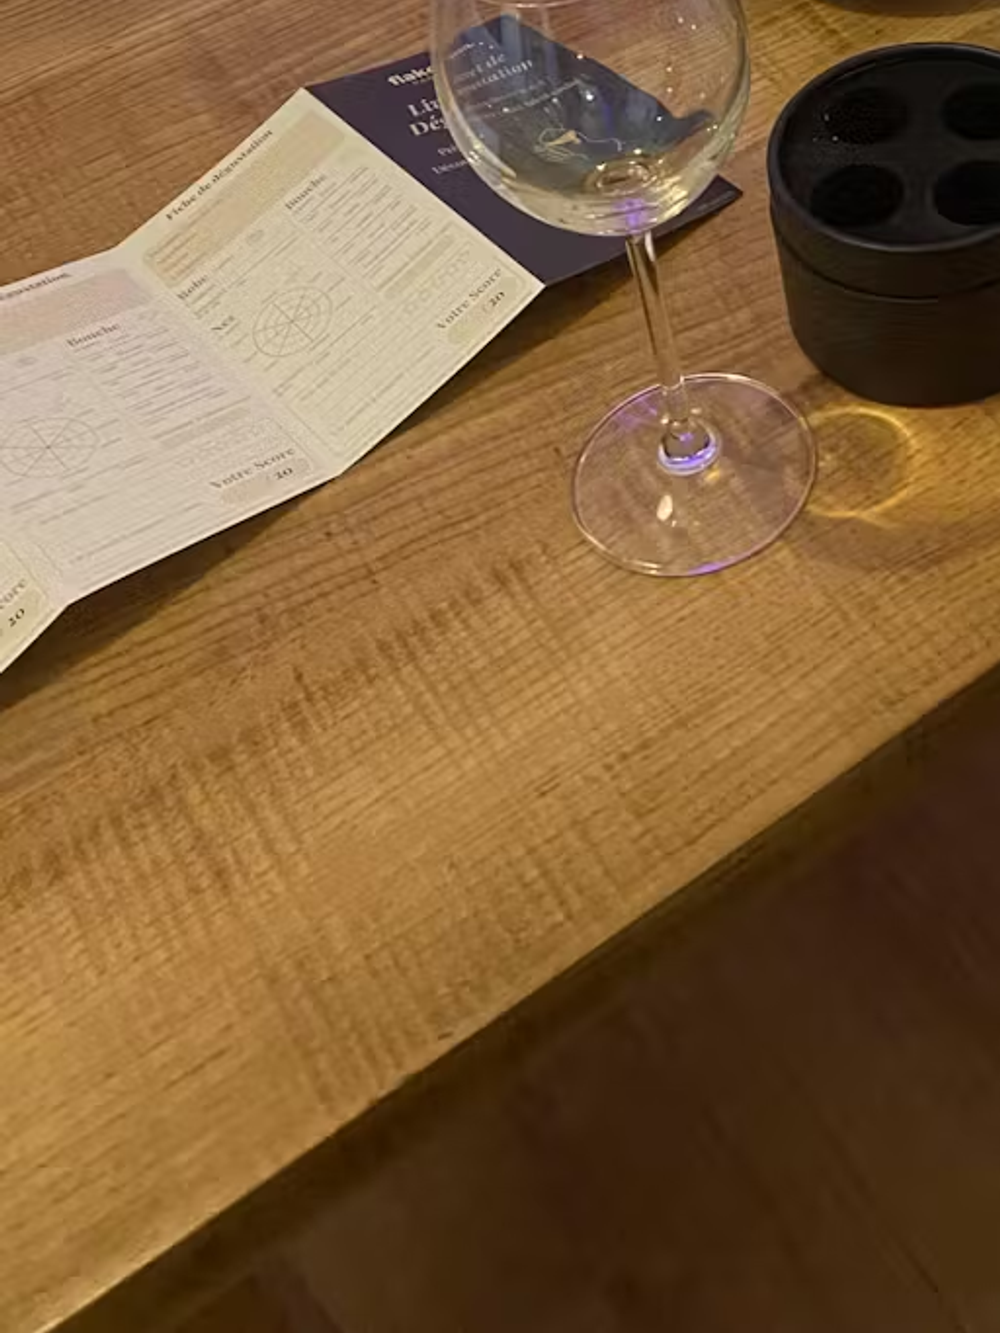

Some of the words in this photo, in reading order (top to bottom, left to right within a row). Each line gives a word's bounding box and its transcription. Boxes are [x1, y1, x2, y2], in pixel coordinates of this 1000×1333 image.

[197, 181, 212, 196] de
[437, 299, 470, 329] Votre
[468, 267, 502, 302] Score
[66, 322, 121, 348] Bouche
[208, 467, 253, 489] Votre
[253, 447, 296, 469] Score
